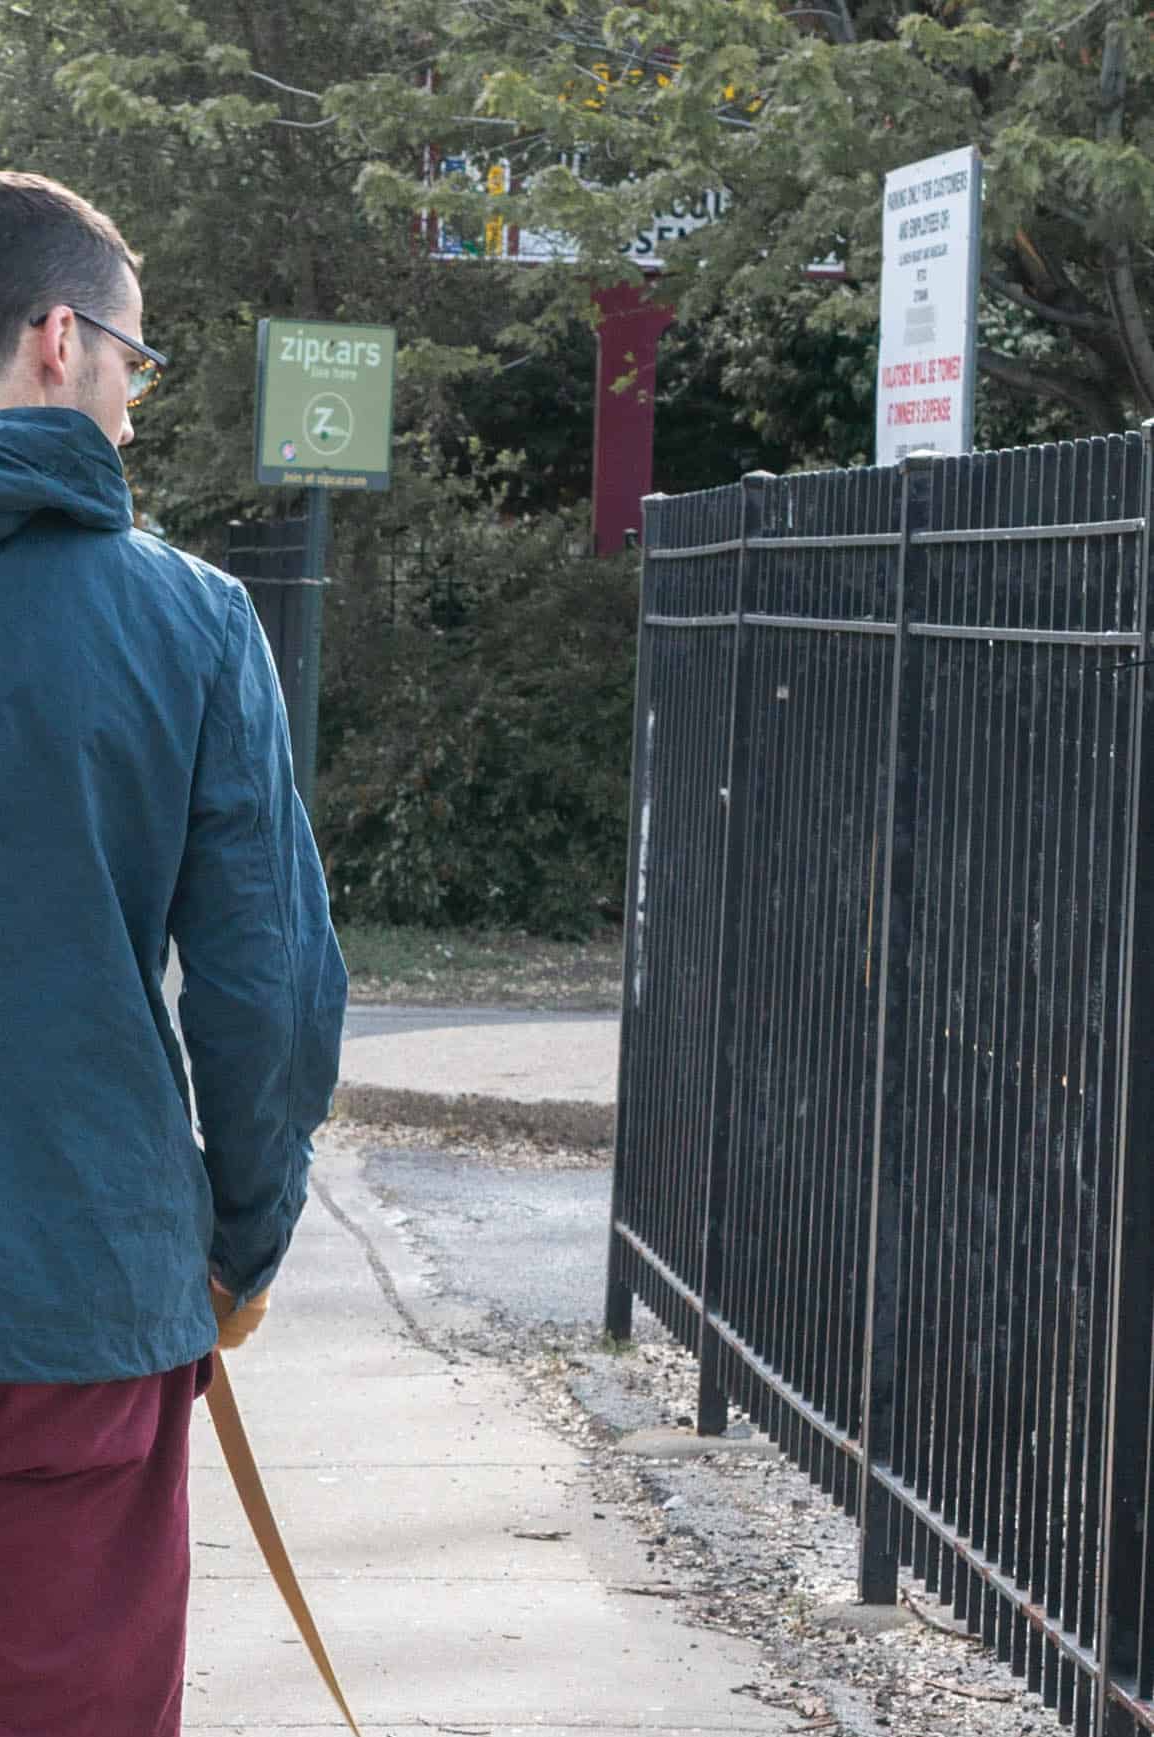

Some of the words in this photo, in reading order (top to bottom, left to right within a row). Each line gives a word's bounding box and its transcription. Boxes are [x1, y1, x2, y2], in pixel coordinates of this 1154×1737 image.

[922, 179, 932, 201] FOR
[934, 171, 967, 198] CUSTOMERS
[280, 329, 381, 370] zipcars
[882, 364, 911, 388] VIOLATORS
[913, 361, 926, 385] WILL
[928, 359, 936, 383] BE
[938, 356, 960, 381] TOWED
[894, 399, 921, 425] OWNER'S
[921, 396, 951, 423] EXPENSE
